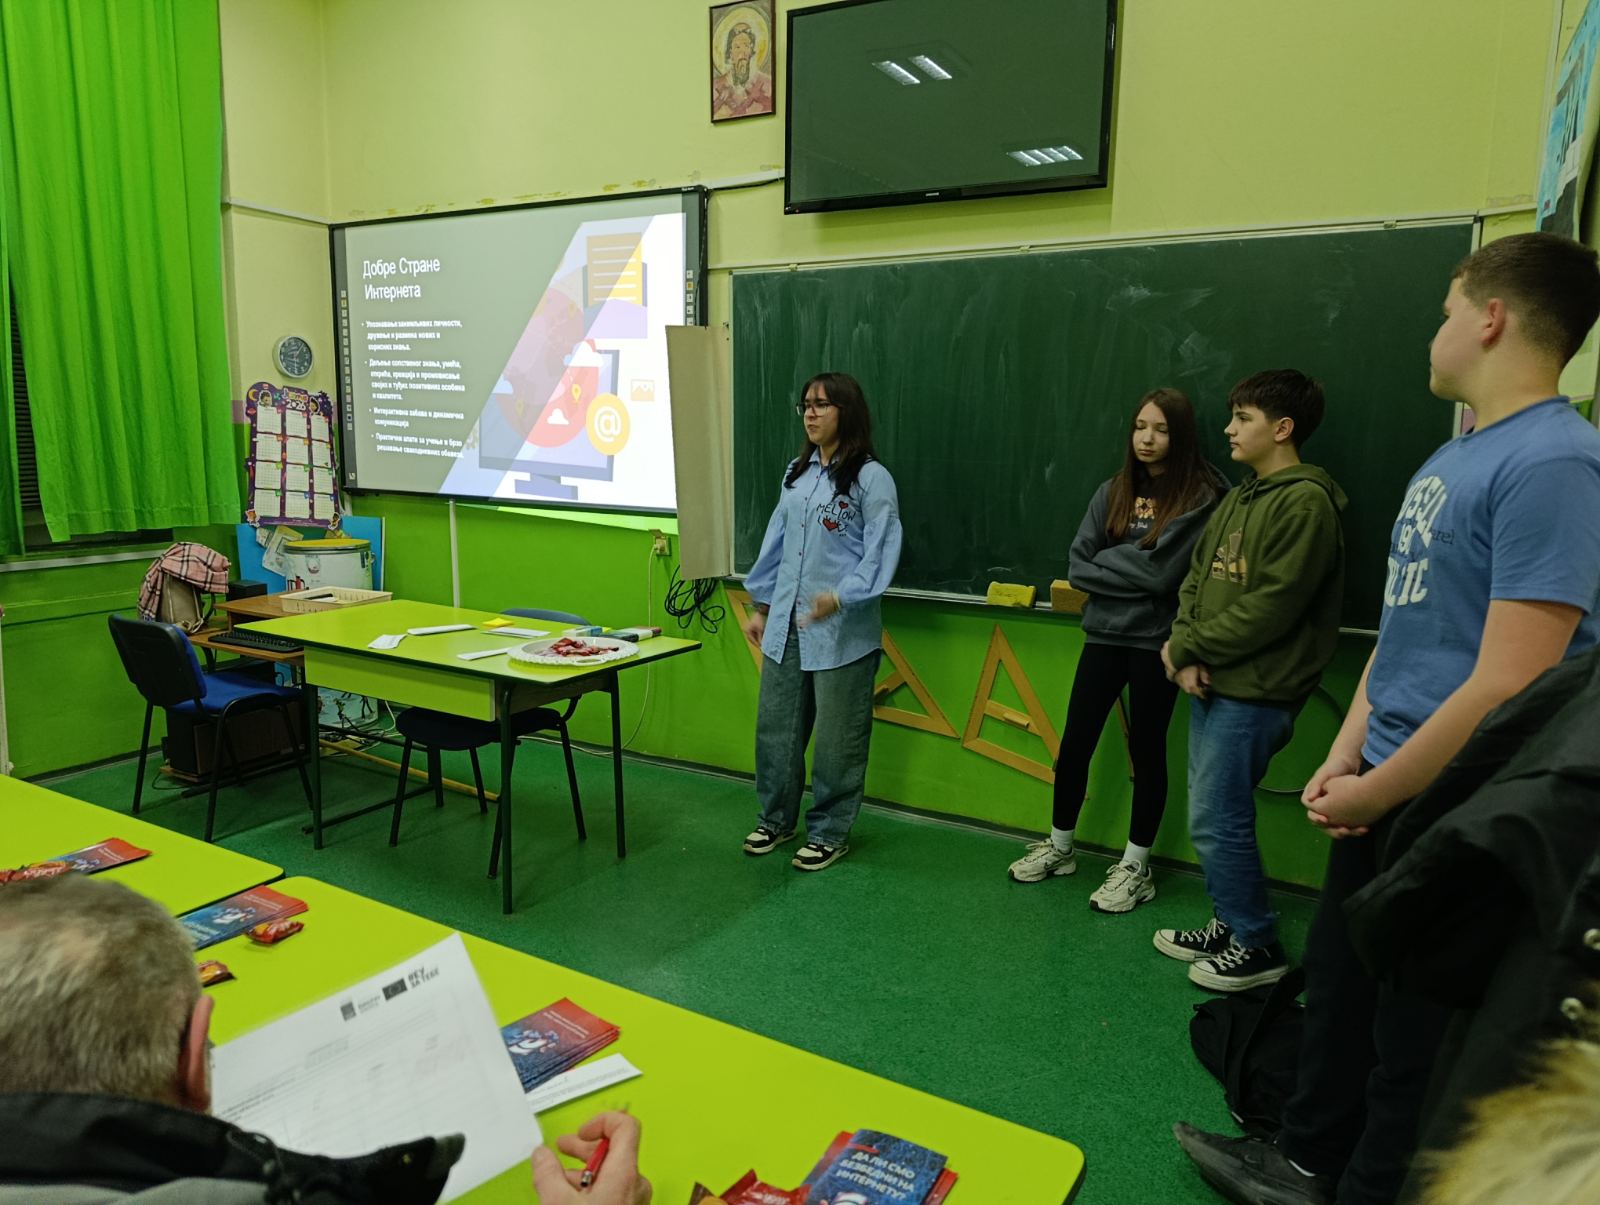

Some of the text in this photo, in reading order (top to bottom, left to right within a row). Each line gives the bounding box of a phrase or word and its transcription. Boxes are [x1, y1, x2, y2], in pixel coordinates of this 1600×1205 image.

[363, 257, 440, 279] Добре Стране
[364, 284, 421, 302] Интернета
[840, 1159, 916, 1193] БЕЗБЕДНИ НА
[851, 1151, 915, 1180] ДА ЛИ СМО
[836, 1170, 907, 1200] ИНТЕРНЕТУ?
